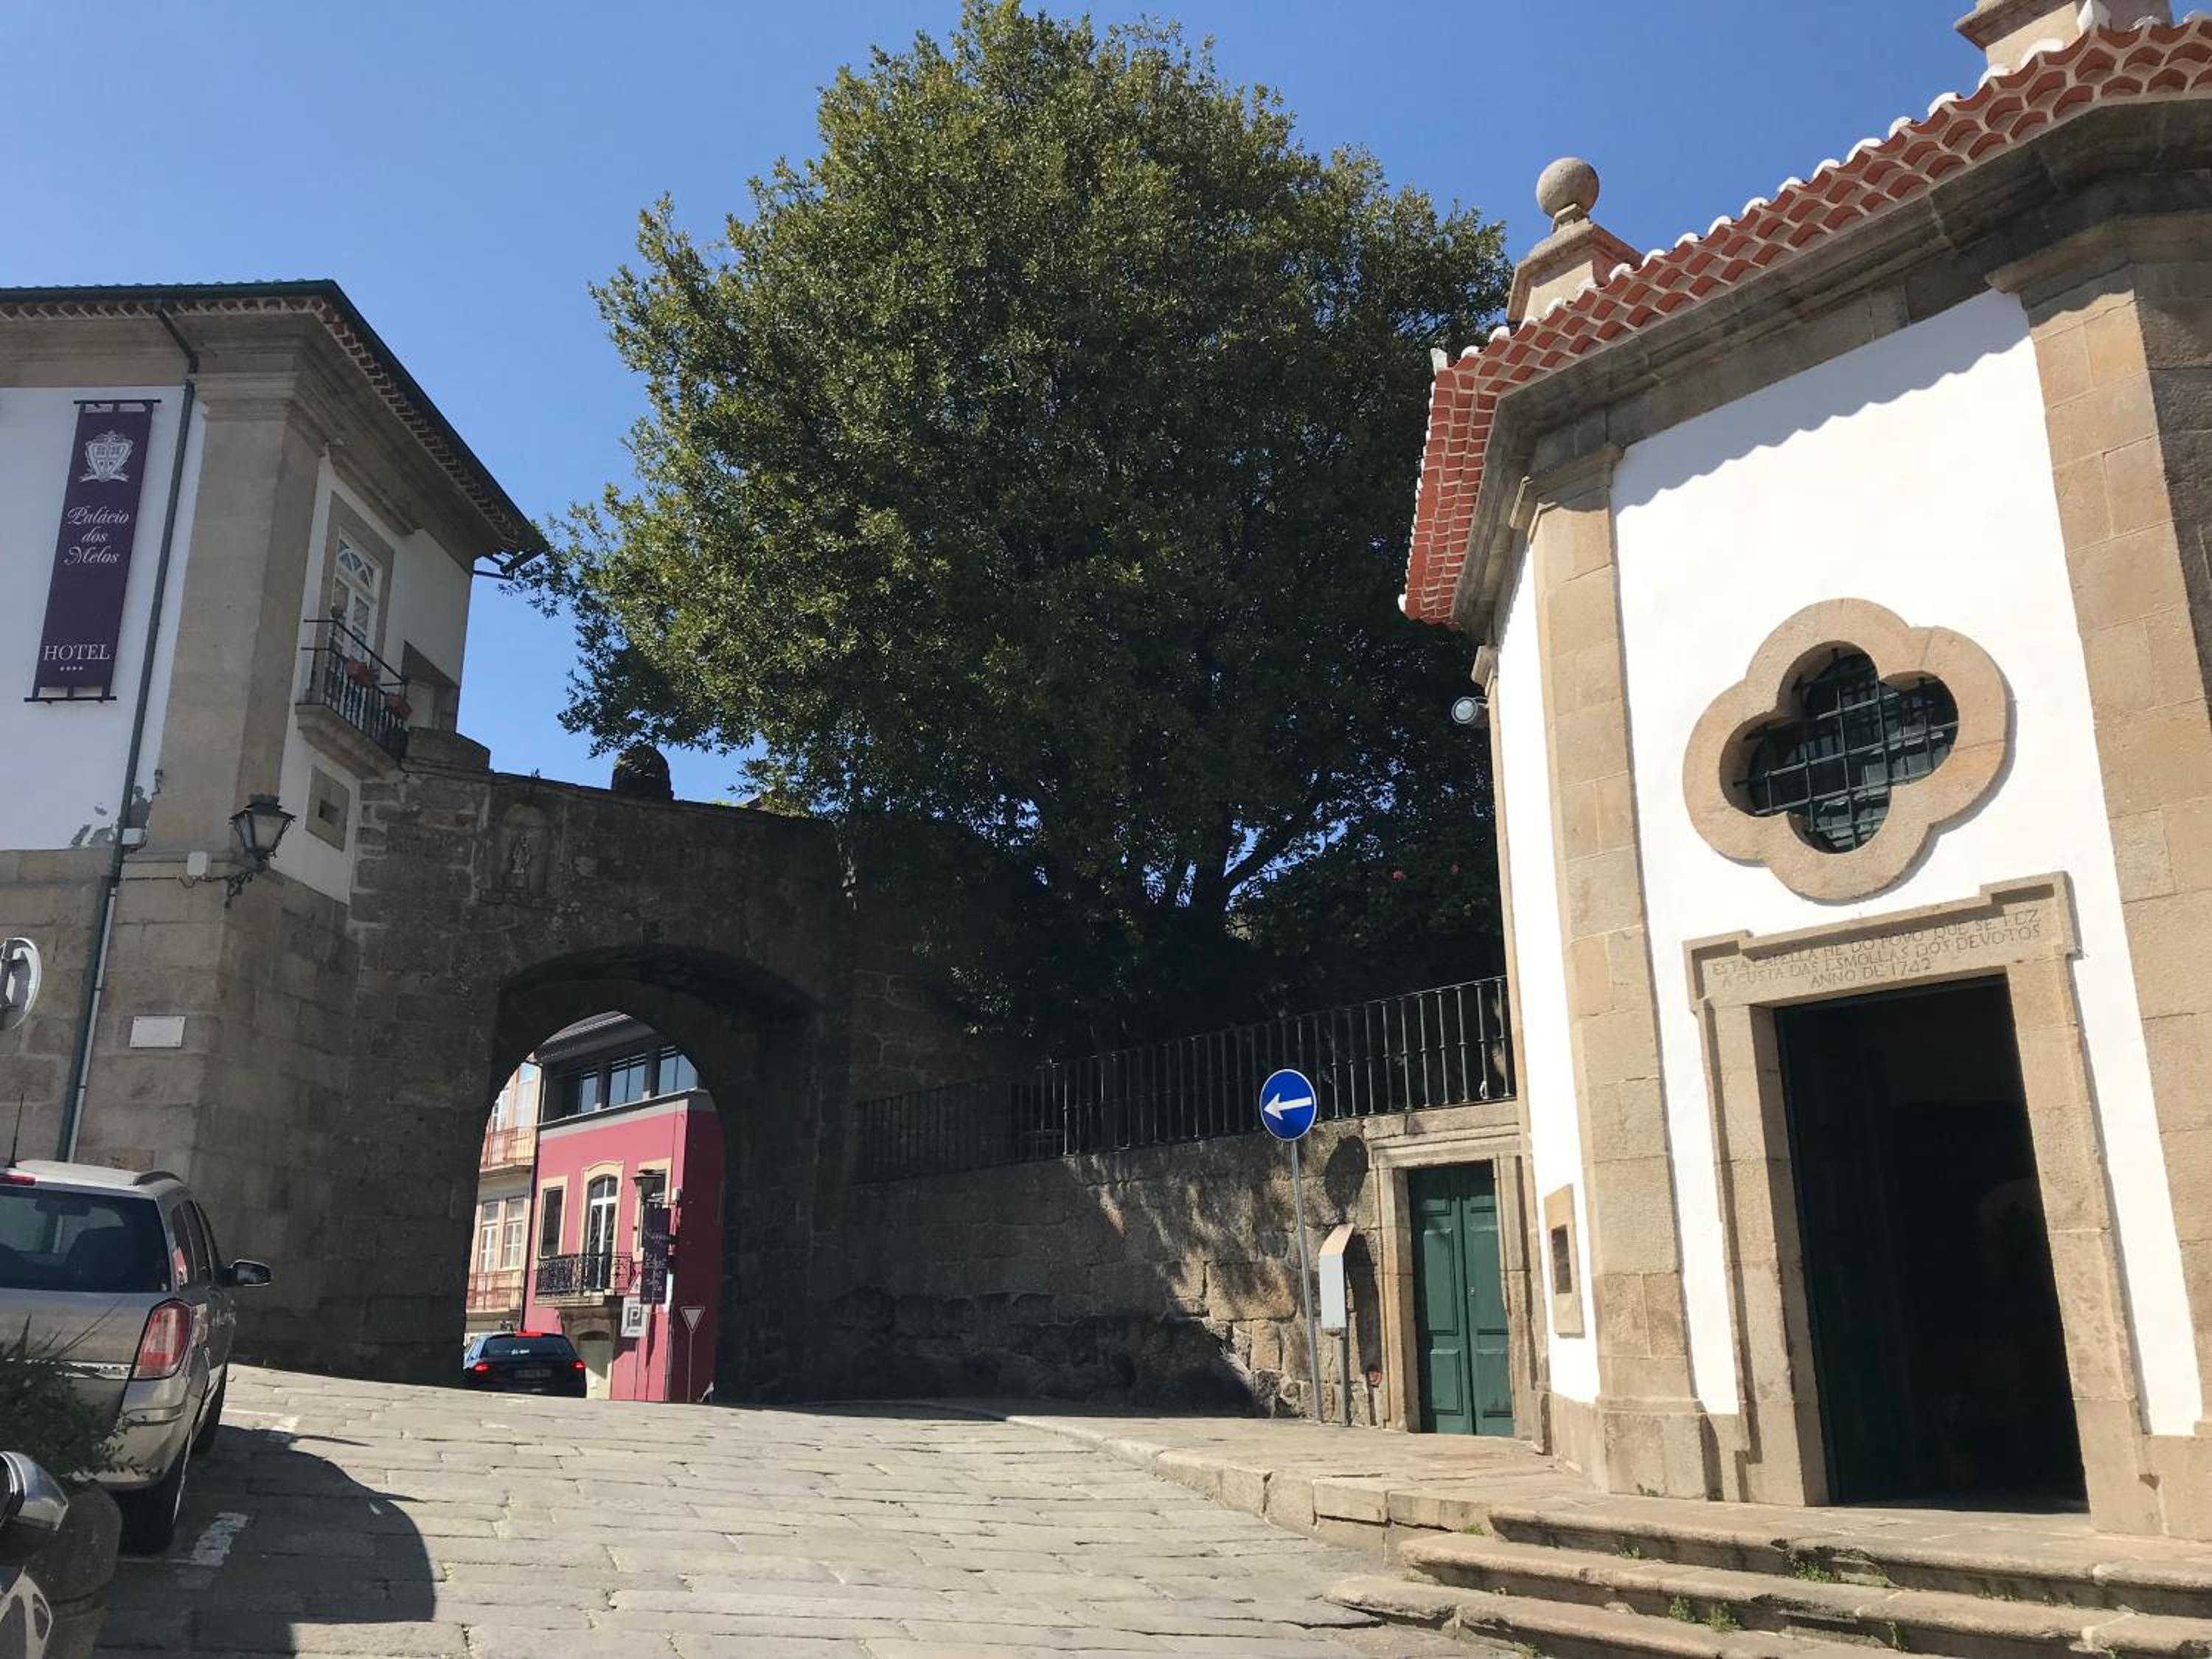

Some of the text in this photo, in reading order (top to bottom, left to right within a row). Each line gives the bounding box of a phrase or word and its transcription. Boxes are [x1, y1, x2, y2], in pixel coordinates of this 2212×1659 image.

[67, 505, 129, 525] Palácio
[82, 526, 108, 543] dos
[64, 545, 119, 565] Melos
[44, 644, 110, 661] HOTEL
[1934, 922, 1969, 940] QUE
[1975, 918, 1994, 932] SE
[1790, 961, 1818, 978] DAS
[1825, 947, 1908, 971] ESMOLLAS
[1916, 941, 1950, 959] DOS
[1956, 922, 2041, 951] DEVOTOS
[1809, 957, 1932, 989] ANNO DE 1742
